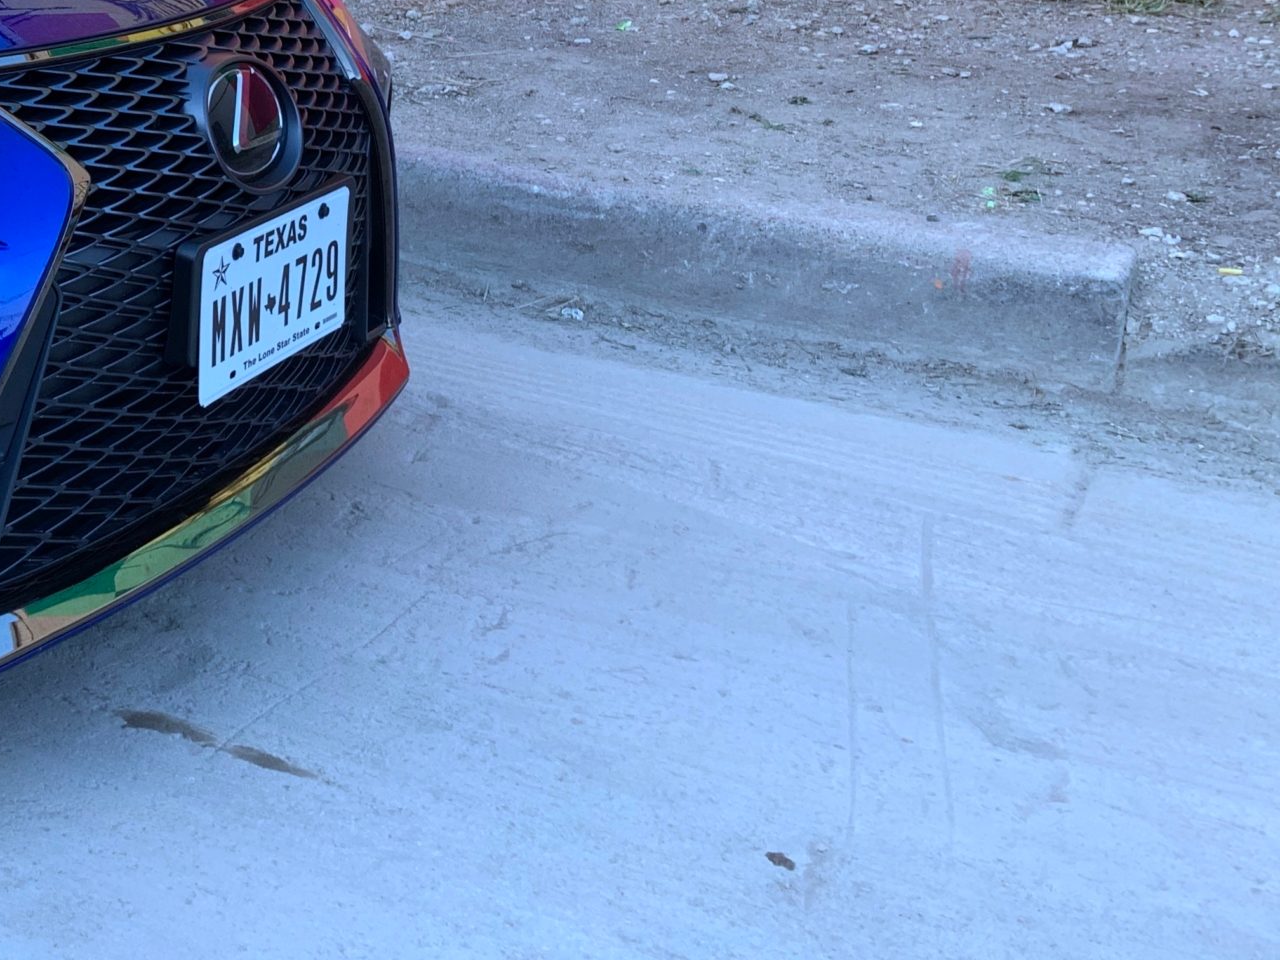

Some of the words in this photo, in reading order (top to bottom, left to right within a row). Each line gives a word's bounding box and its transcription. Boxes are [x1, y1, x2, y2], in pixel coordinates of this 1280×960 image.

[253, 214, 308, 263] TEXAS
[211, 277, 263, 368] MXW
[277, 239, 339, 327] 4729
[243, 357, 257, 371] The
[257, 347, 275, 362] Lone
[276, 337, 291, 352] Star
[292, 327, 310, 342] State
